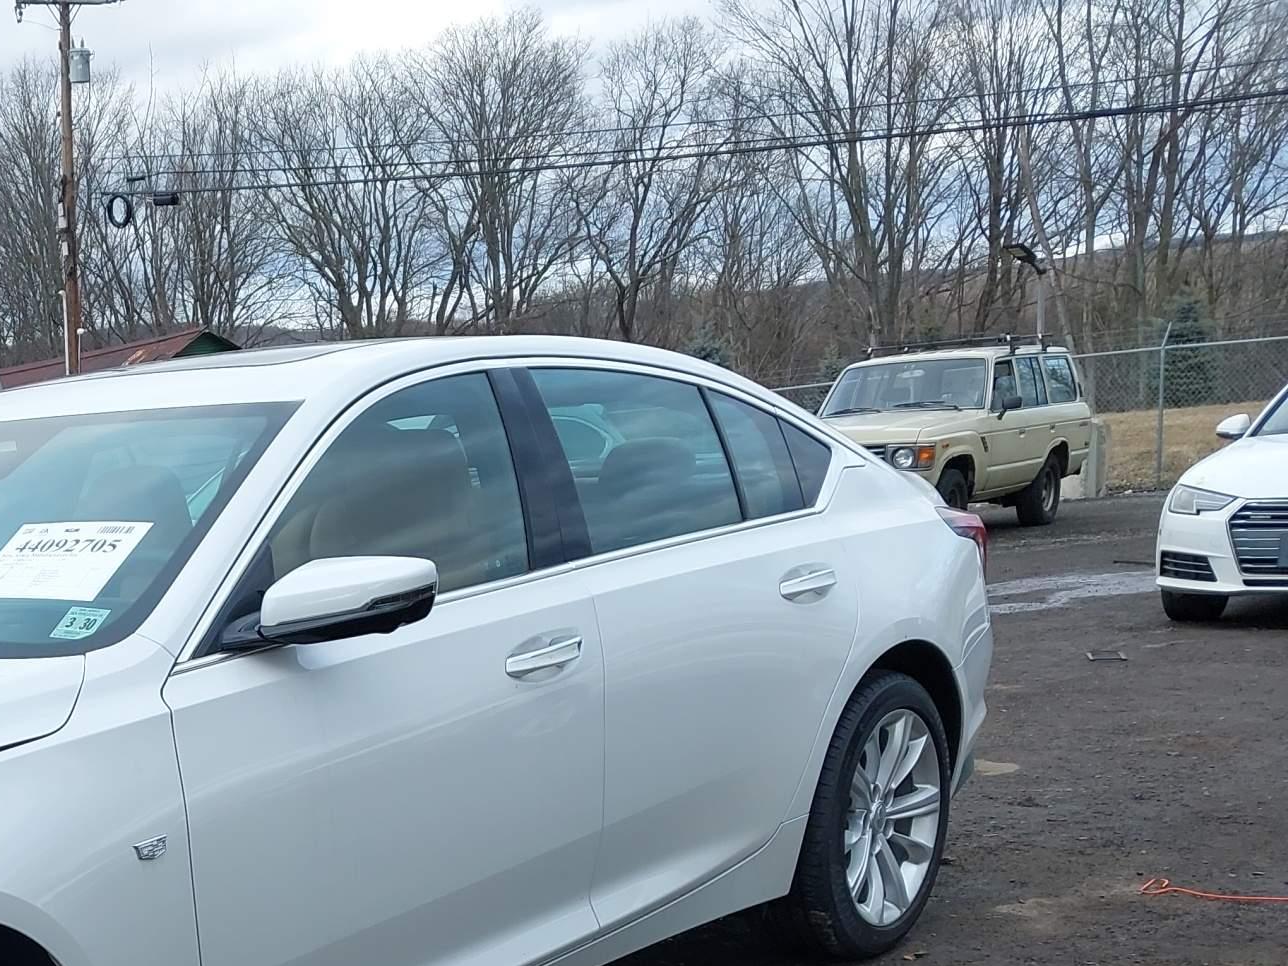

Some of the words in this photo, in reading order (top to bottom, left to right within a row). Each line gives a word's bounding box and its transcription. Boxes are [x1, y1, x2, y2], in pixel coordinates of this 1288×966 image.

[15, 538, 123, 553] 44092705
[64, 616, 77, 628] 3
[78, 617, 98, 631] 30
